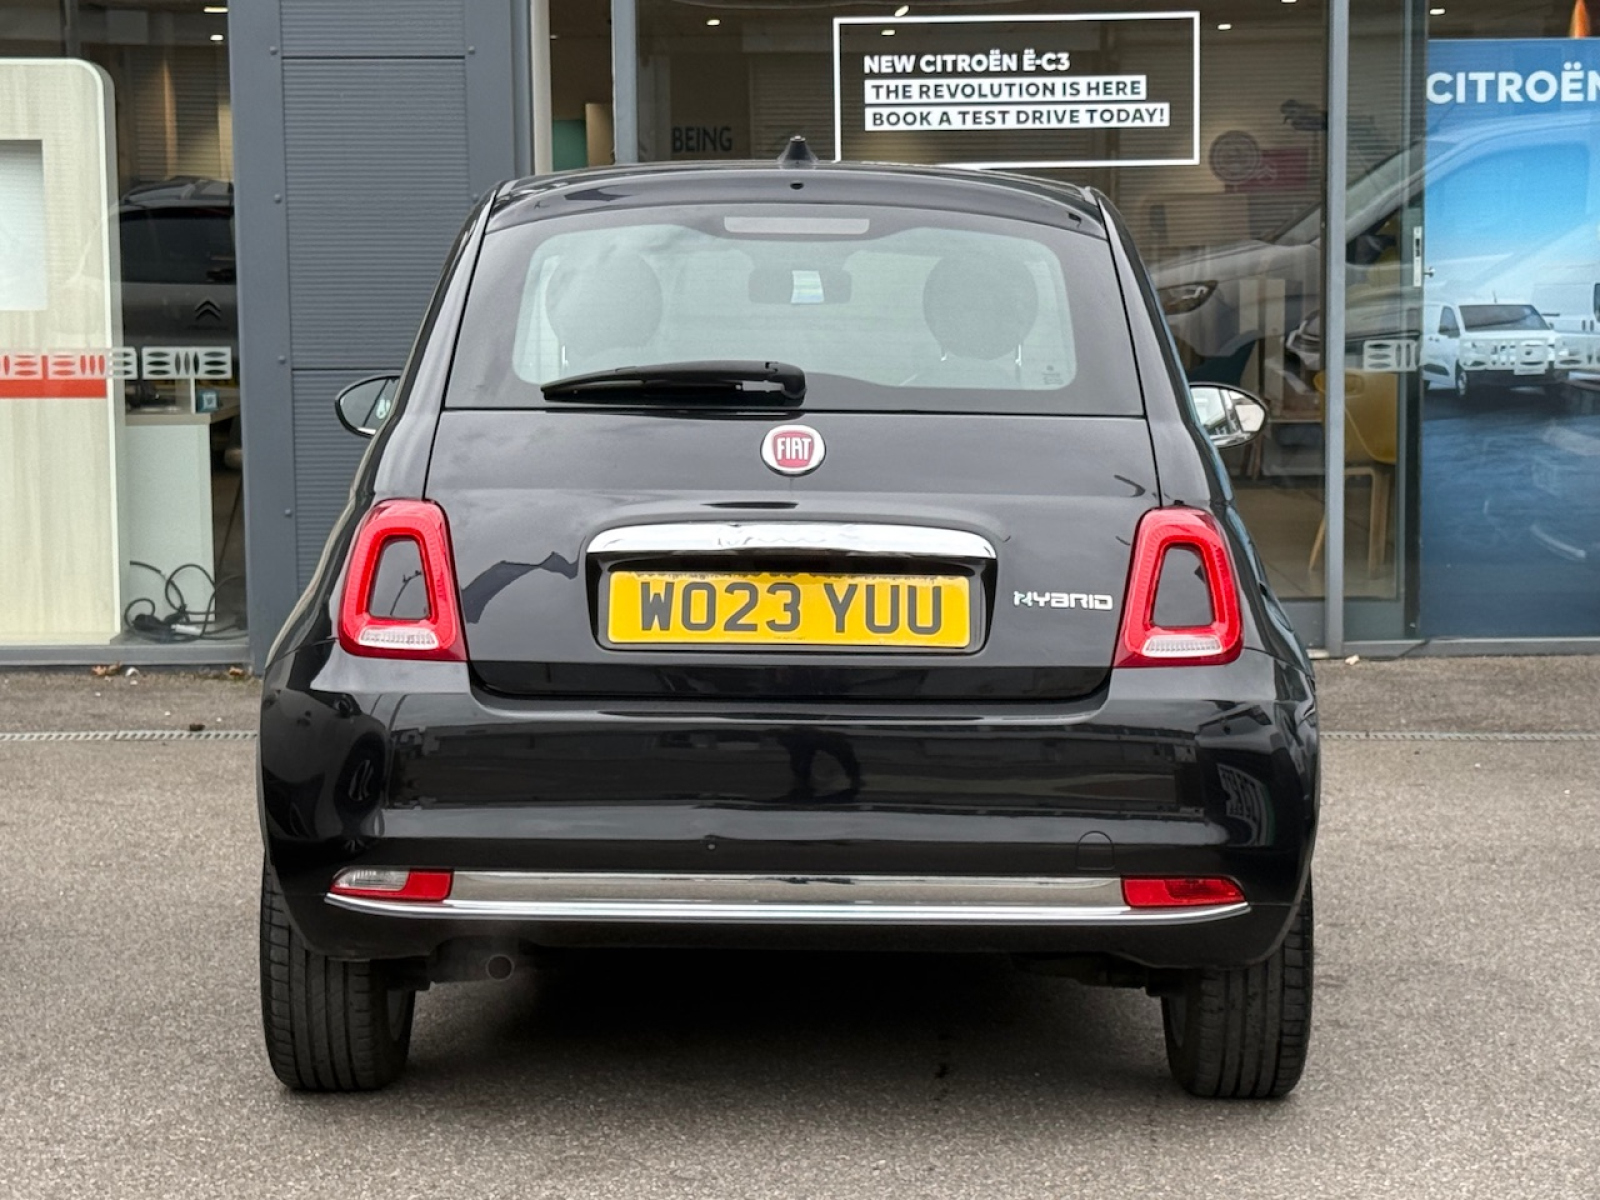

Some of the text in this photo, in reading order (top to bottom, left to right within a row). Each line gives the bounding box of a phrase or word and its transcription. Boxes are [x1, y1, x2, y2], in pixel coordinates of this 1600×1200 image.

[864, 48, 1070, 73] NEW CITROËN Ë-C3
[871, 81, 1141, 99] THE REVOLUTION IS HERE
[873, 108, 1164, 126] BOOK A TEST DRIVE TODAY!
[672, 126, 732, 152] BEING
[777, 437, 811, 460] FIAT
[824, 583, 941, 635] YUU
[1014, 591, 1113, 610] HYBRID
